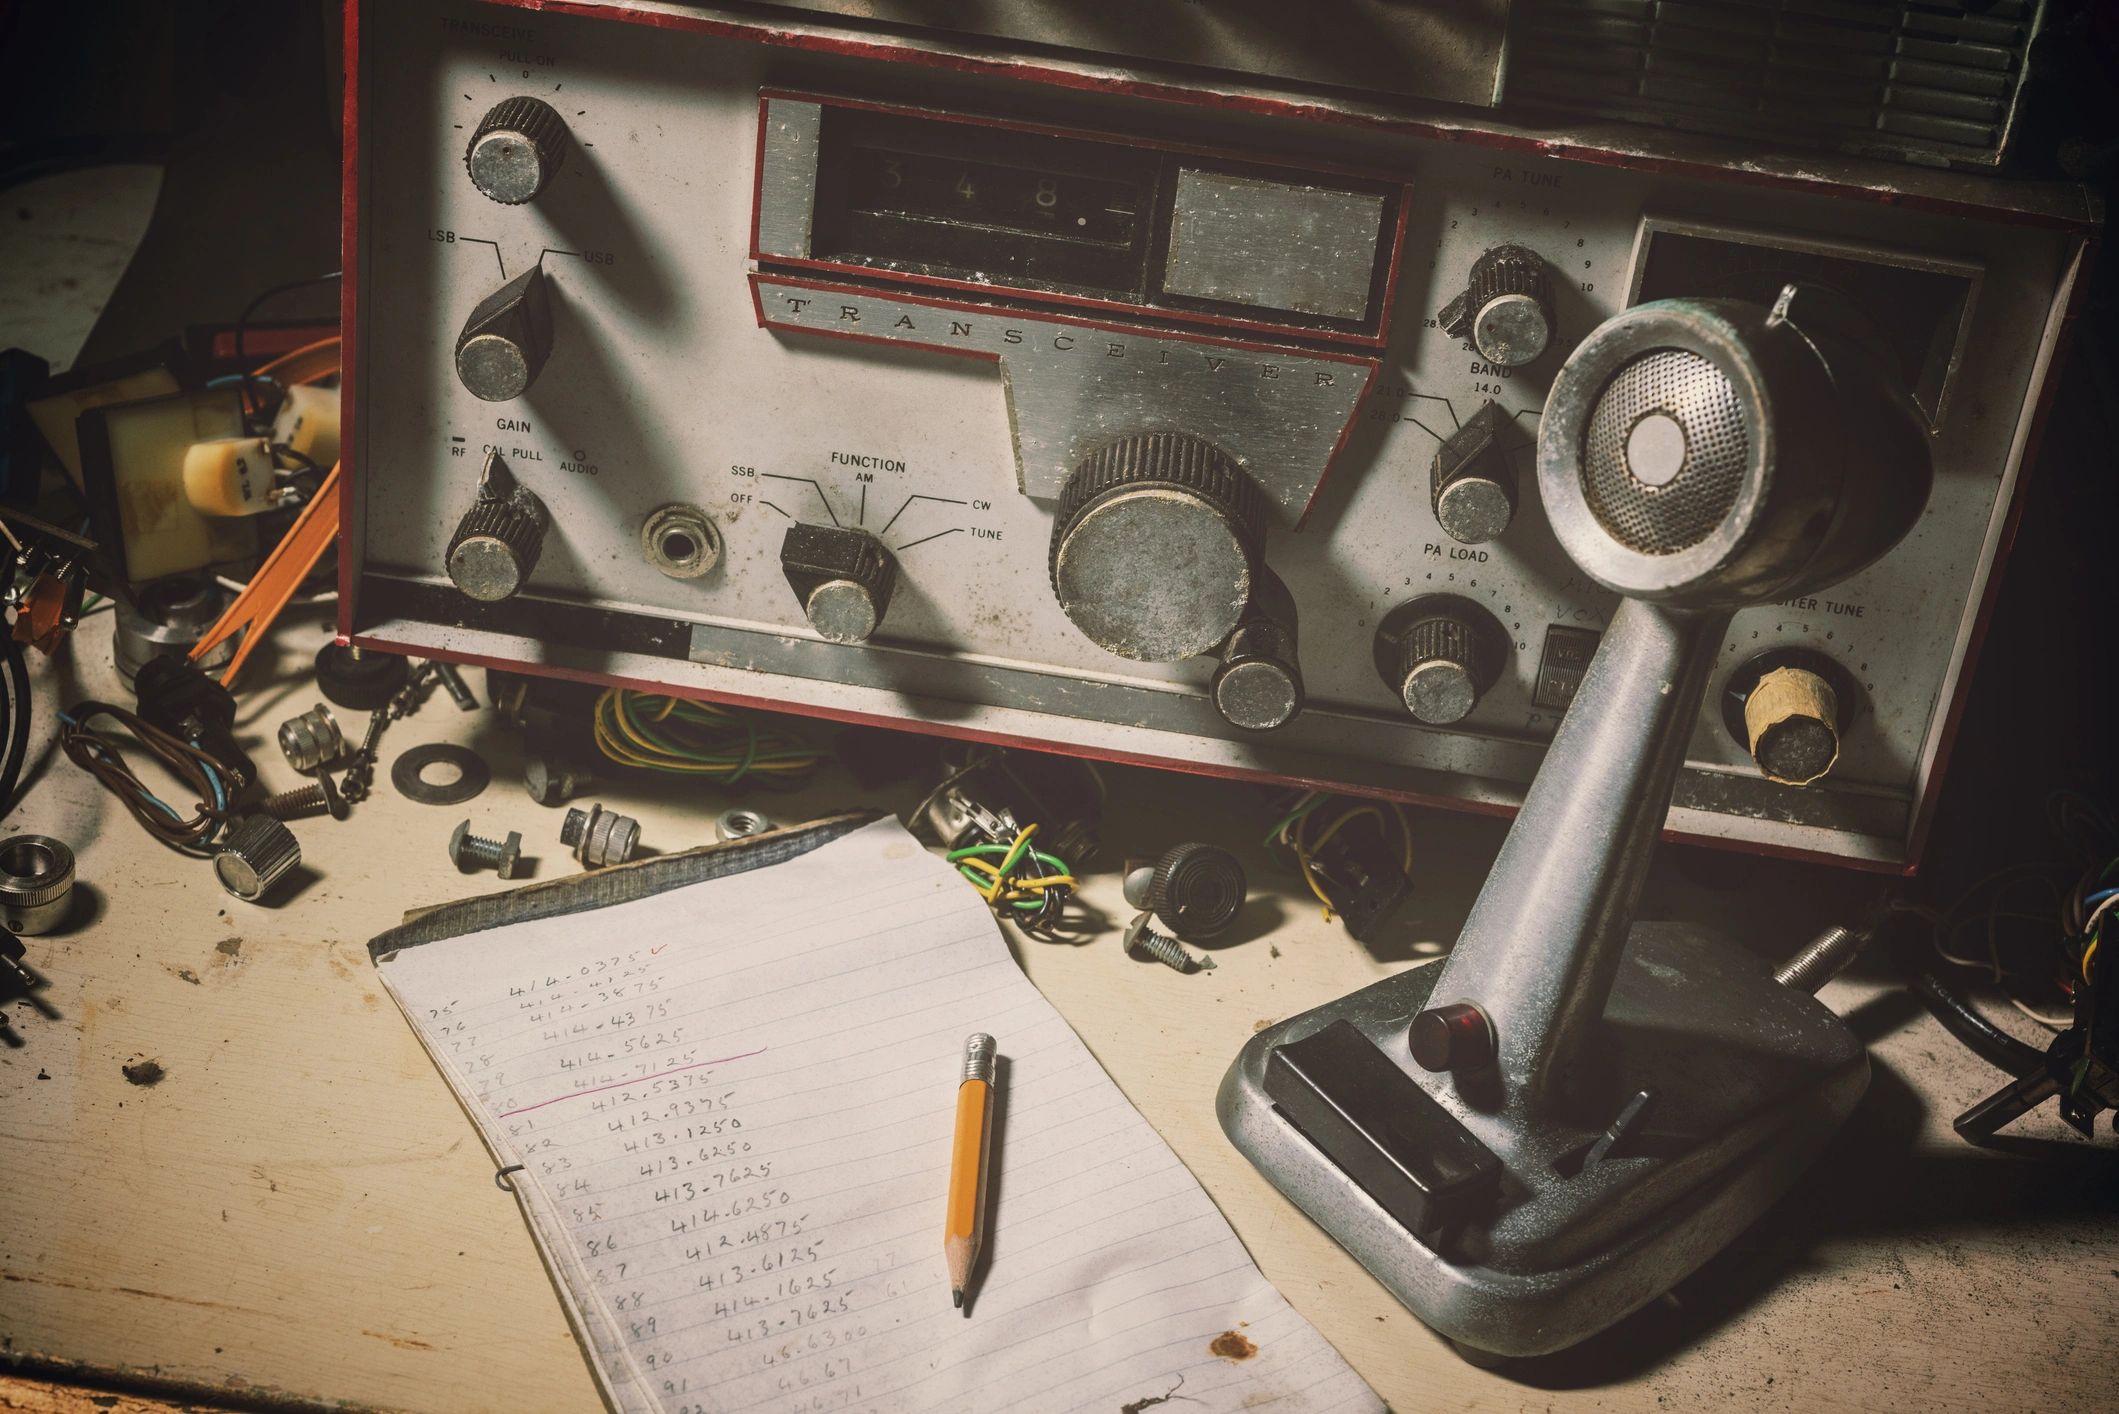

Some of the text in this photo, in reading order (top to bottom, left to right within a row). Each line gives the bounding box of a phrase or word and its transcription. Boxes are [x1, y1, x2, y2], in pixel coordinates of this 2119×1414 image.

[1520, 170, 1563, 188] TUNE
[1471, 207, 1478, 216] 3
[1450, 219, 1458, 229] 2
[427, 229, 456, 244] LSB
[1576, 238, 1584, 248] 8
[584, 251, 615, 266] USB
[1584, 260, 1591, 269] 9
[1581, 282, 1594, 292] 10
[787, 297, 1337, 388] TRANSCEIVER
[1470, 362, 1513, 379] BAND
[1474, 382, 1501, 395] 14.0
[496, 418, 531, 433] GAIN
[452, 447, 467, 458] RF
[483, 444, 543, 462] CAL PULL
[560, 461, 599, 476] AUDIO
[831, 451, 907, 473] FUNCTION
[731, 465, 755, 477] SSB
[855, 472, 874, 484] AM
[730, 493, 753, 504] OFF
[972, 500, 992, 511] CW
[970, 526, 1004, 541] TUNE
[1424, 543, 1489, 563] PA LOAD
[1404, 577, 1411, 586] 3
[1426, 572, 1432, 581] 4
[1448, 573, 1455, 581] 5
[1470, 579, 1477, 588] 6
[1384, 587, 1391, 596] 2
[1504, 605, 1511, 613] 8
[1825, 601, 1865, 618] TUNE
[1514, 622, 1520, 630] 9
[1514, 641, 1526, 650] 10
[1729, 643, 1736, 652] 2
[1752, 631, 1759, 639] 3
[1776, 624, 1783, 632] 4
[1802, 624, 1809, 633] 5
[1826, 631, 1834, 640] 6
[1860, 662, 1868, 671] 8
[1867, 683, 1874, 692] 9
[429, 1000, 459, 1019] 75
[440, 1021, 466, 1035] 76
[451, 1036, 477, 1052] 77
[465, 1054, 495, 1074] 78
[542, 1157, 572, 1174] 83
[587, 1235, 618, 1257] 86
[615, 1291, 644, 1311] 88
[630, 1316, 657, 1338] 89
